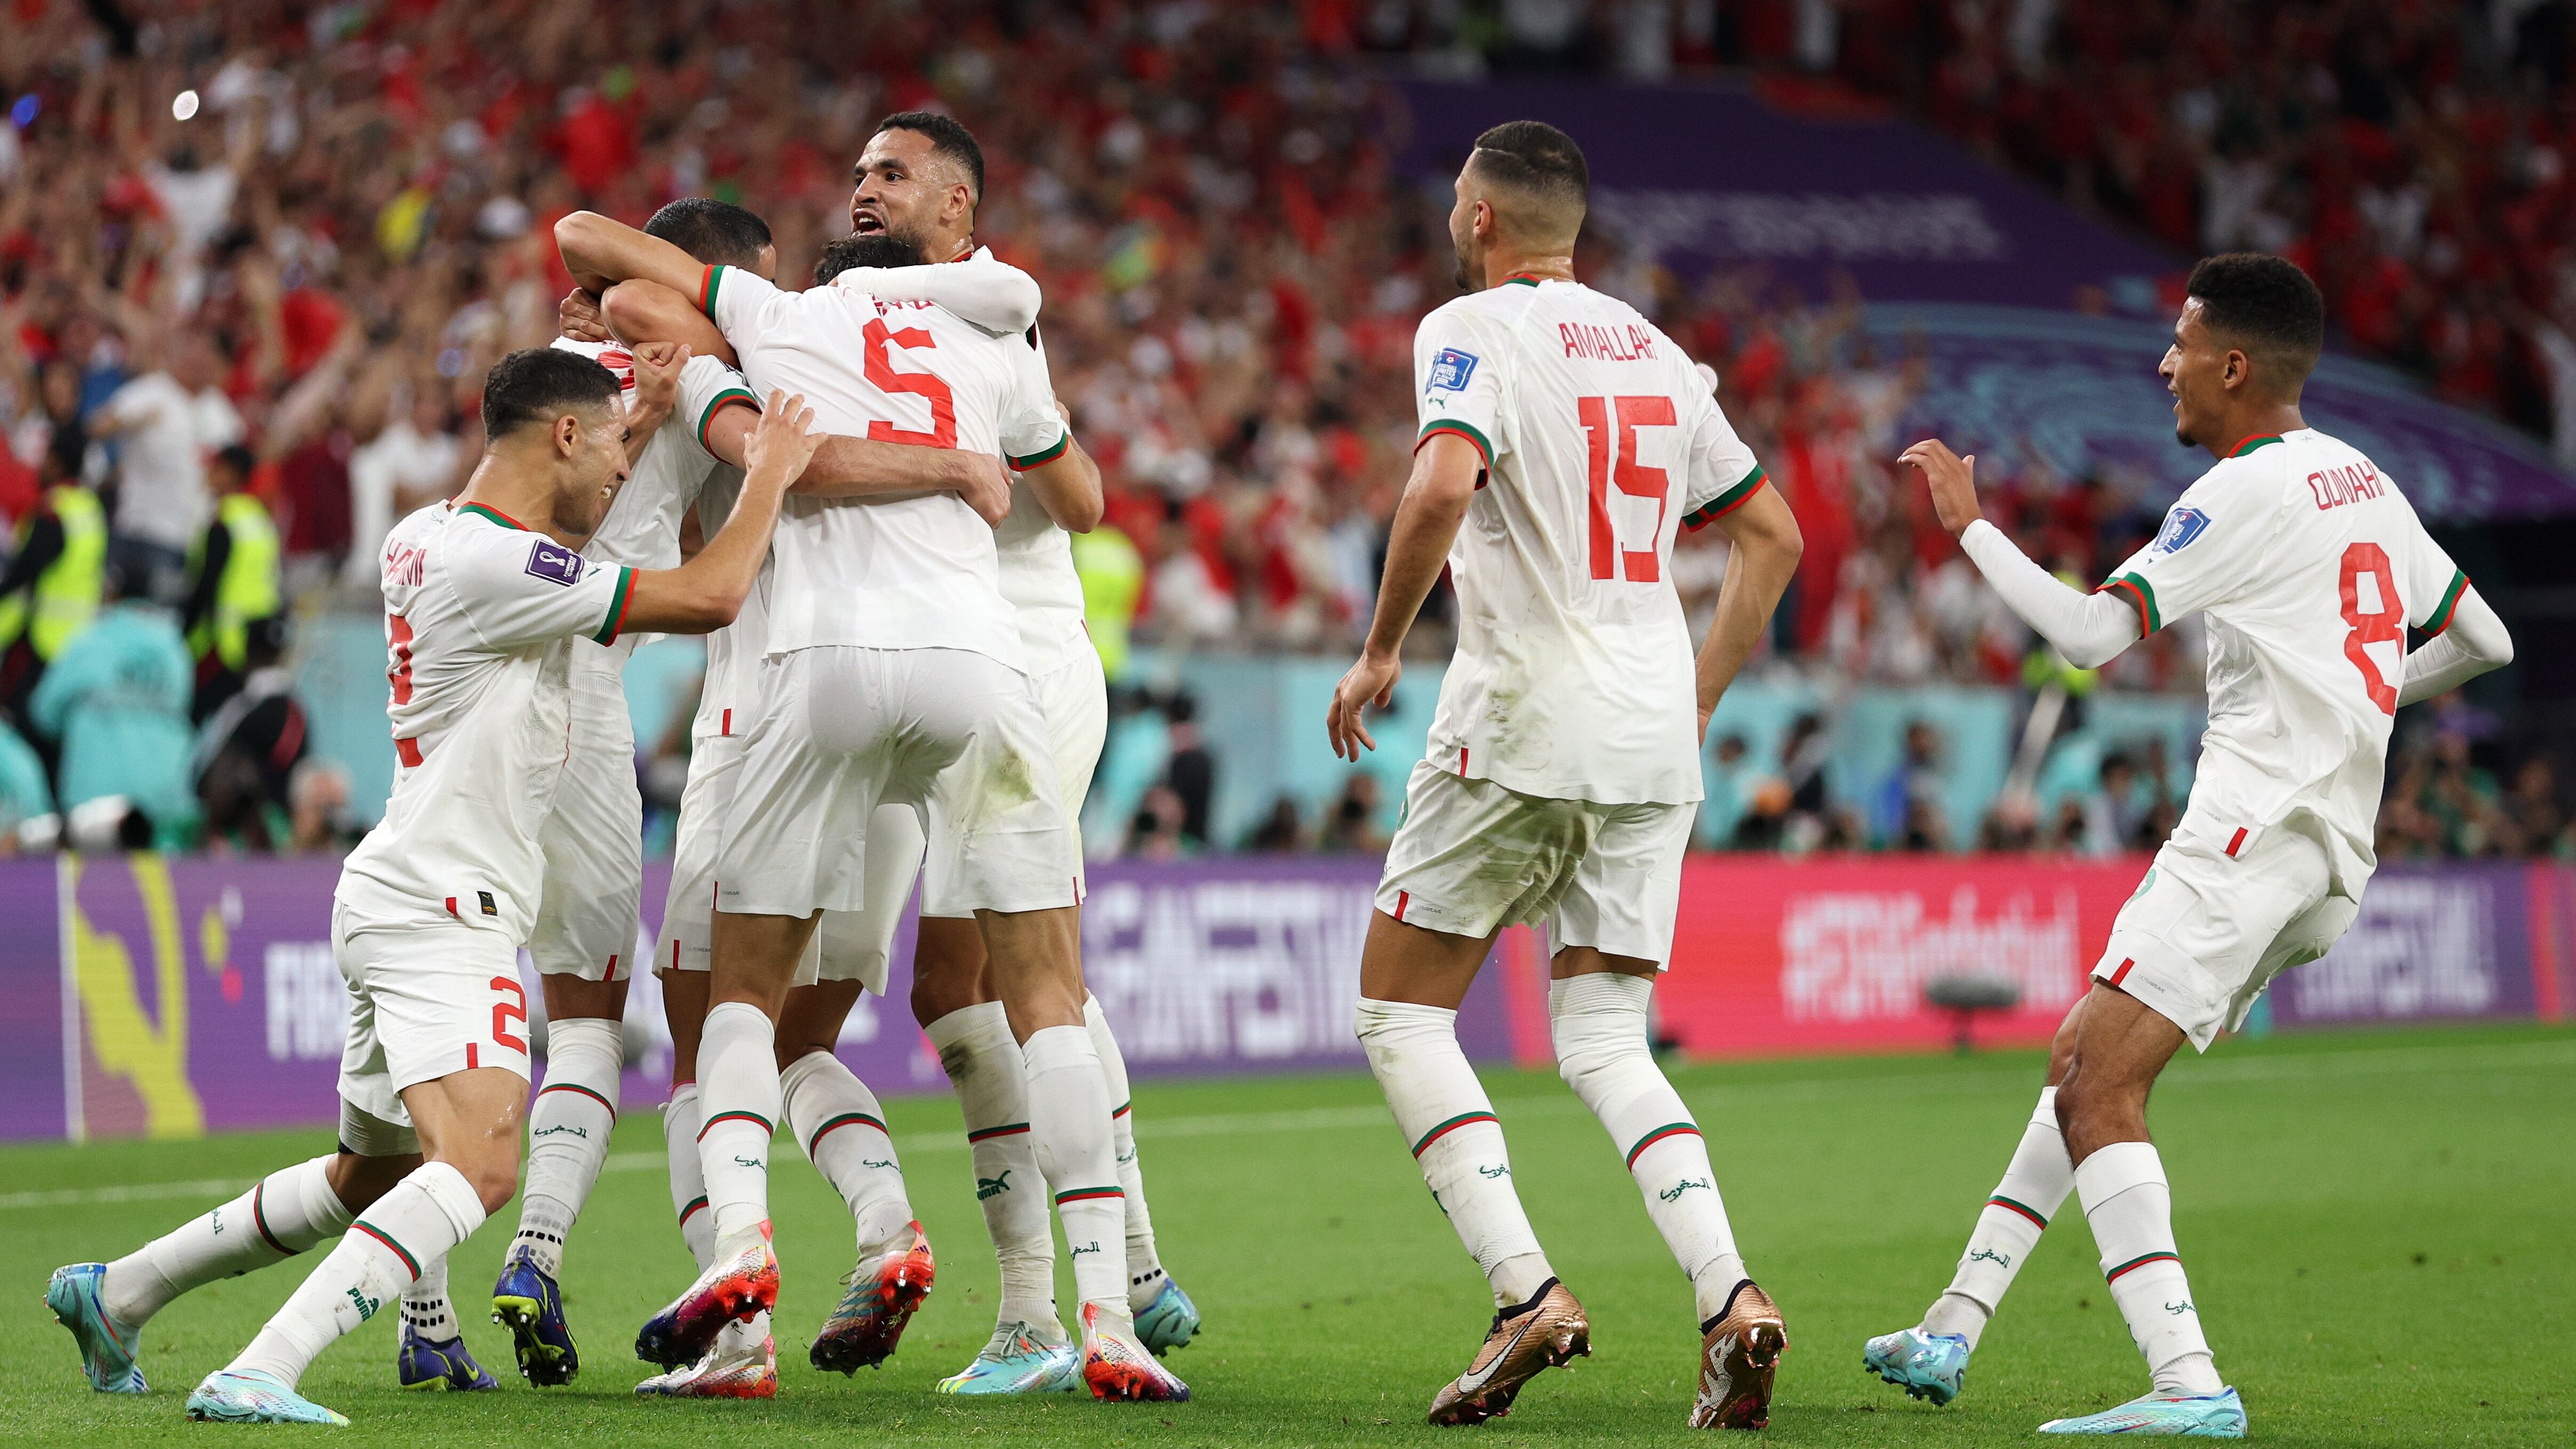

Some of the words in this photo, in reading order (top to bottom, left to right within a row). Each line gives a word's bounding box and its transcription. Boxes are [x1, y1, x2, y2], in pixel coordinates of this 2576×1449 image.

[862, 318, 957, 449] 5
[1558, 322, 1658, 361] AMALLAH
[1578, 395, 1677, 582] 15
[2308, 461, 2385, 511] OUNAHI
[2339, 543, 2404, 717] 8
[490, 976, 527, 1057] 2
